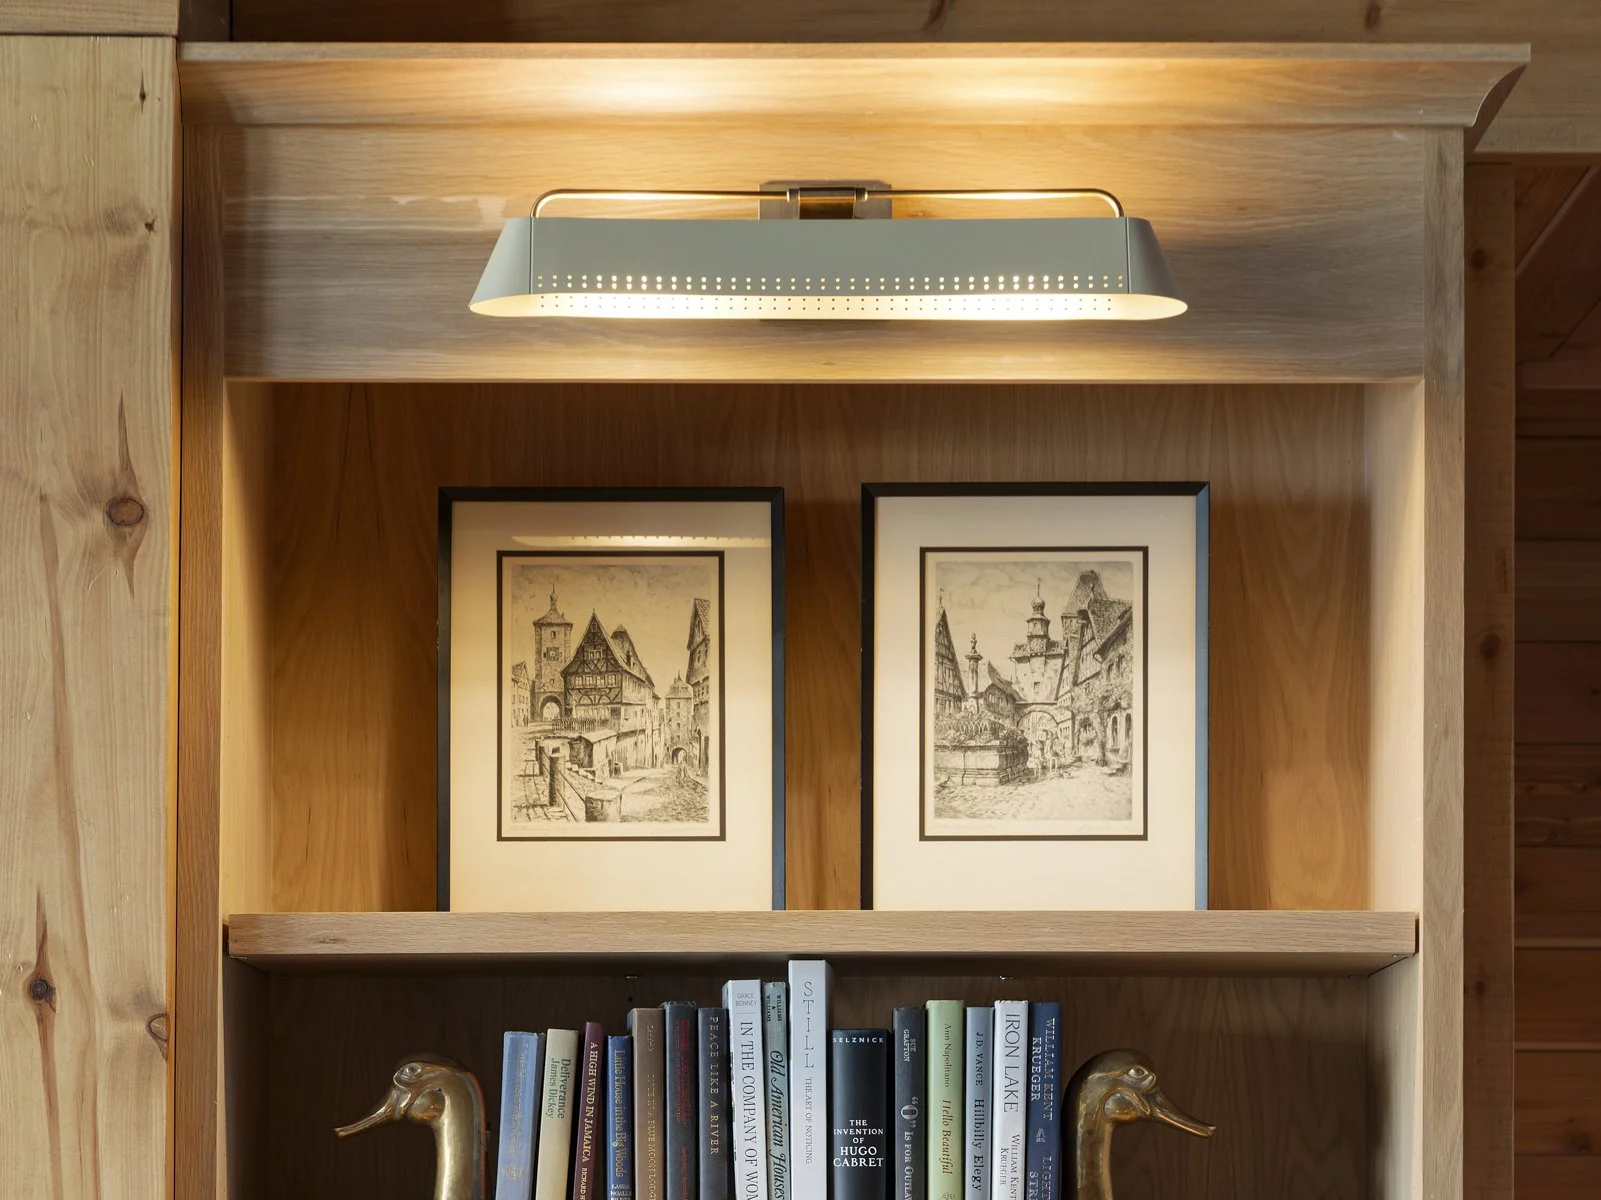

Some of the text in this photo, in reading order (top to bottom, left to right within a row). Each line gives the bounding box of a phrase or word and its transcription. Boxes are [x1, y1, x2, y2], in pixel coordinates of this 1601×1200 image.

[740, 1021, 753, 1036] IN
[742, 1040, 755, 1071] THE
[802, 981, 815, 1068] STILL
[942, 1023, 953, 1088] Ann Napolitano
[546, 1058, 560, 1119] James Dickey
[557, 1058, 572, 1119] Deliverance
[709, 1016, 719, 1154] PEACE LIKE A RIVER
[975, 1031, 984, 1086] J.D. VANCE
[1003, 1013, 1020, 1113] IRON LAKE
[1030, 1036, 1042, 1102] KRUEGER
[1043, 1017, 1056, 1121] WILLIAM KENT
[582, 1041, 599, 1163] A HIGH WIND IN JAMAICA
[612, 1049, 627, 1178] Little House in the Big Woods
[647, 1119, 656, 1142] BLUE
[743, 1075, 757, 1144] COMPANY
[769, 1050, 788, 1200] Old American Houses
[805, 1076, 813, 1165] THE ART OF NOTICING
[648, 1143, 656, 1172] MOON
[745, 1148, 758, 1167] OF
[832, 1157, 884, 1167] CABRET
[839, 1146, 877, 1156] HUGO
[904, 1143, 913, 1164] FOR
[939, 1099, 954, 1175] Hello Beautiful
[972, 1099, 985, 1191] Hillbilly Elegy
[999, 1147, 1009, 1186] KRUEGER
[1010, 1133, 1020, 1200] WILLIAM KENT
[579, 1167, 588, 1195] RICHARD
